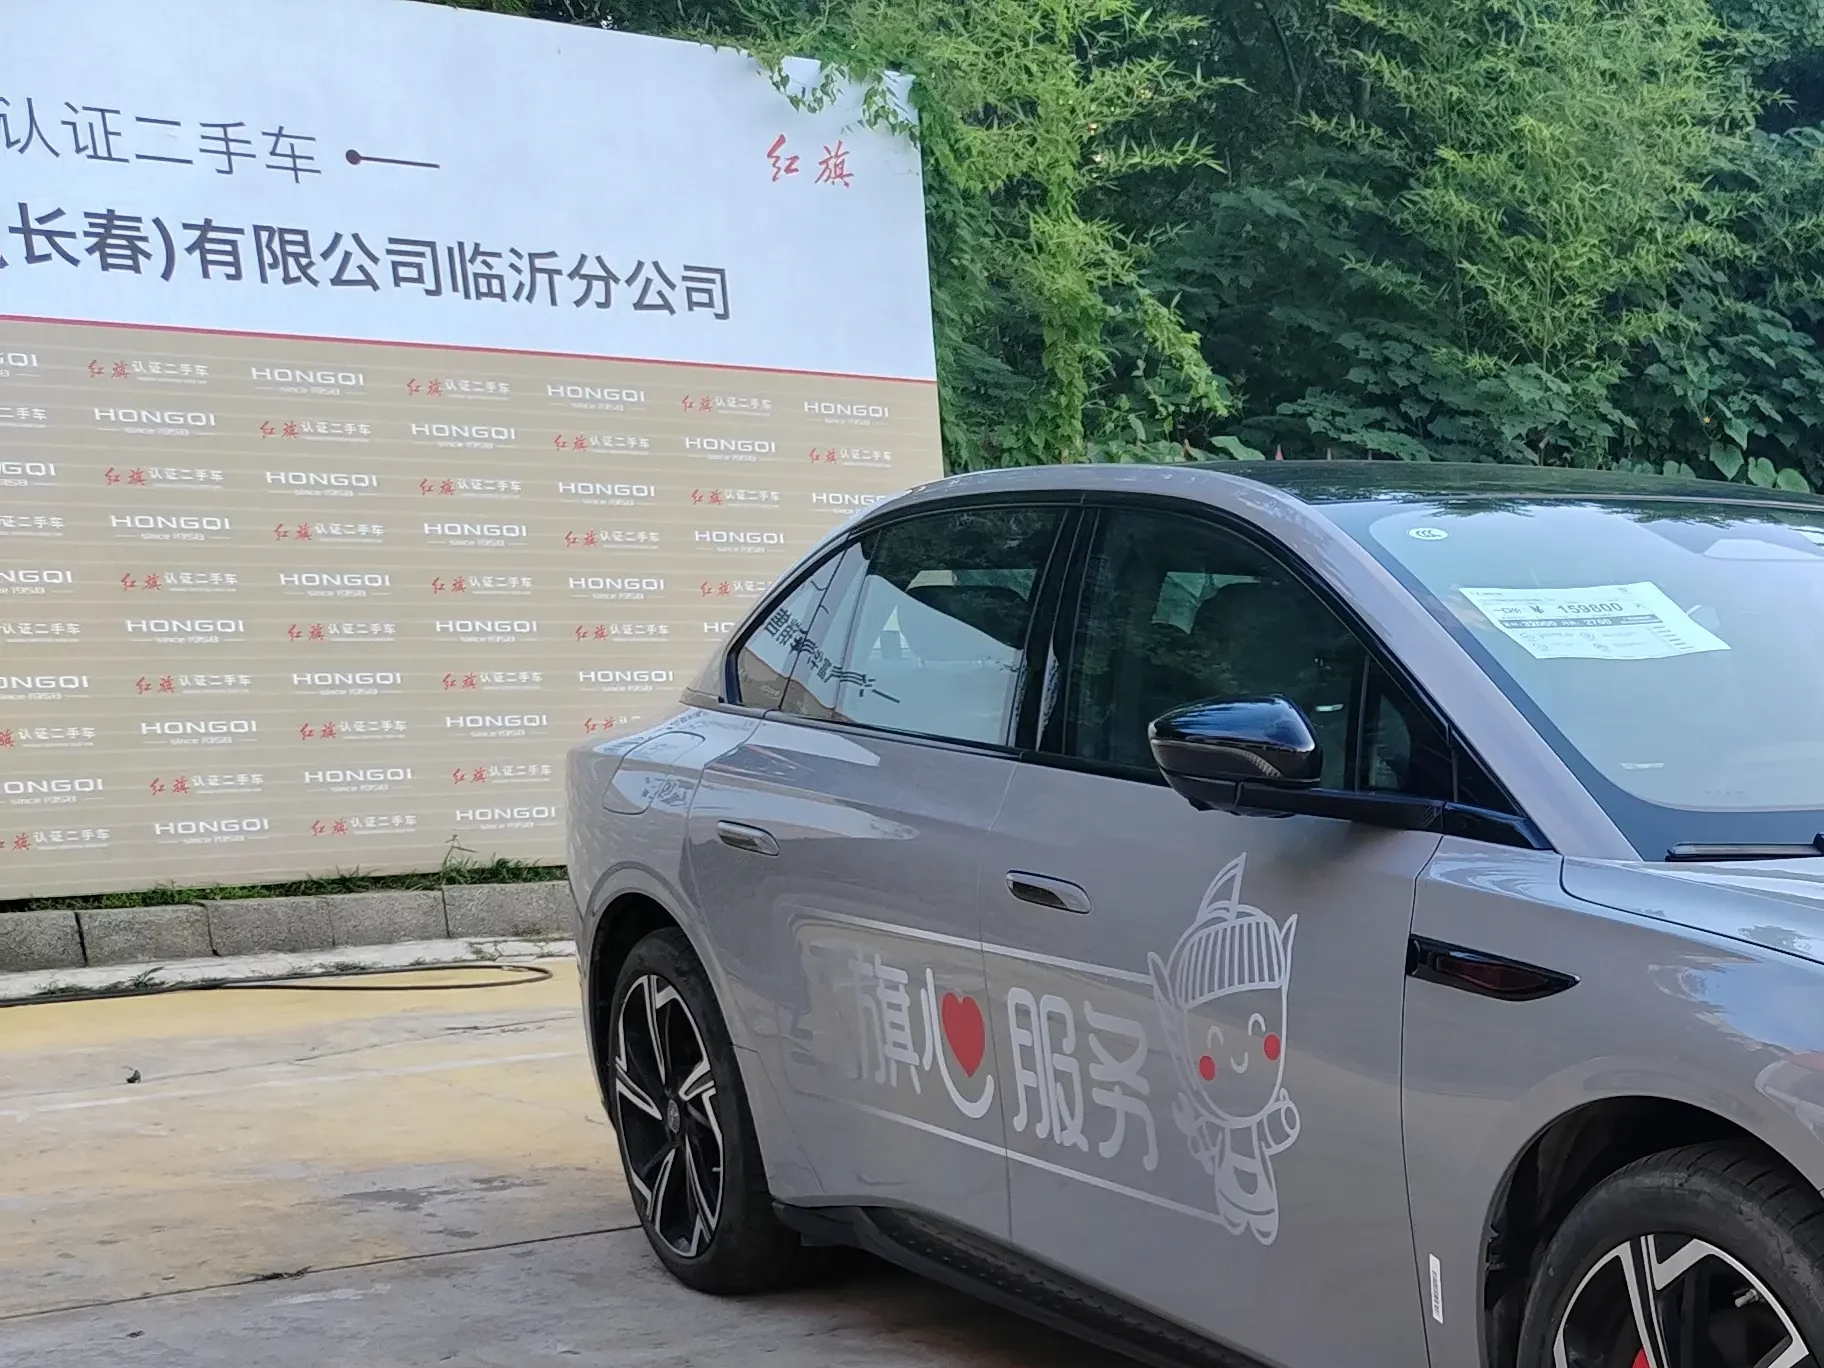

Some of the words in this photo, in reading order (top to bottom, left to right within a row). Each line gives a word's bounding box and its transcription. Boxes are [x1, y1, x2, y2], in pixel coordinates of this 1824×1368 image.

[0, 97, 321, 184] 认证二手车
[766, 133, 855, 189] 红旗
[0, 202, 730, 321] 长春)有限公司临沂分公司
[251, 367, 364, 385] HONGQI
[547, 384, 644, 402] HONGQI
[94, 408, 215, 425] HONGQI
[804, 402, 888, 417] HONGQI
[410, 424, 515, 439] HONGQI
[685, 437, 775, 452] HONGQI
[266, 472, 377, 487] HONGQI
[558, 482, 654, 496] HONGQI
[110, 515, 230, 530] HONGQI
[424, 523, 526, 536] HONGQI
[695, 531, 784, 544] HONGQI
[280, 574, 390, 587] HONGQI
[569, 577, 664, 590] HONGQI
[1556, 602, 1624, 615] 159800
[125, 620, 244, 633] HONGQI
[436, 620, 536, 633] HONGQI
[292, 673, 401, 685] HONGQI
[578, 671, 673, 683] HONGQI
[141, 720, 257, 734] HONGQI
[446, 715, 547, 728] HONGQI
[304, 768, 412, 783] HONGQI
[456, 806, 555, 821] HONGQI
[155, 818, 268, 834] HONGQI
